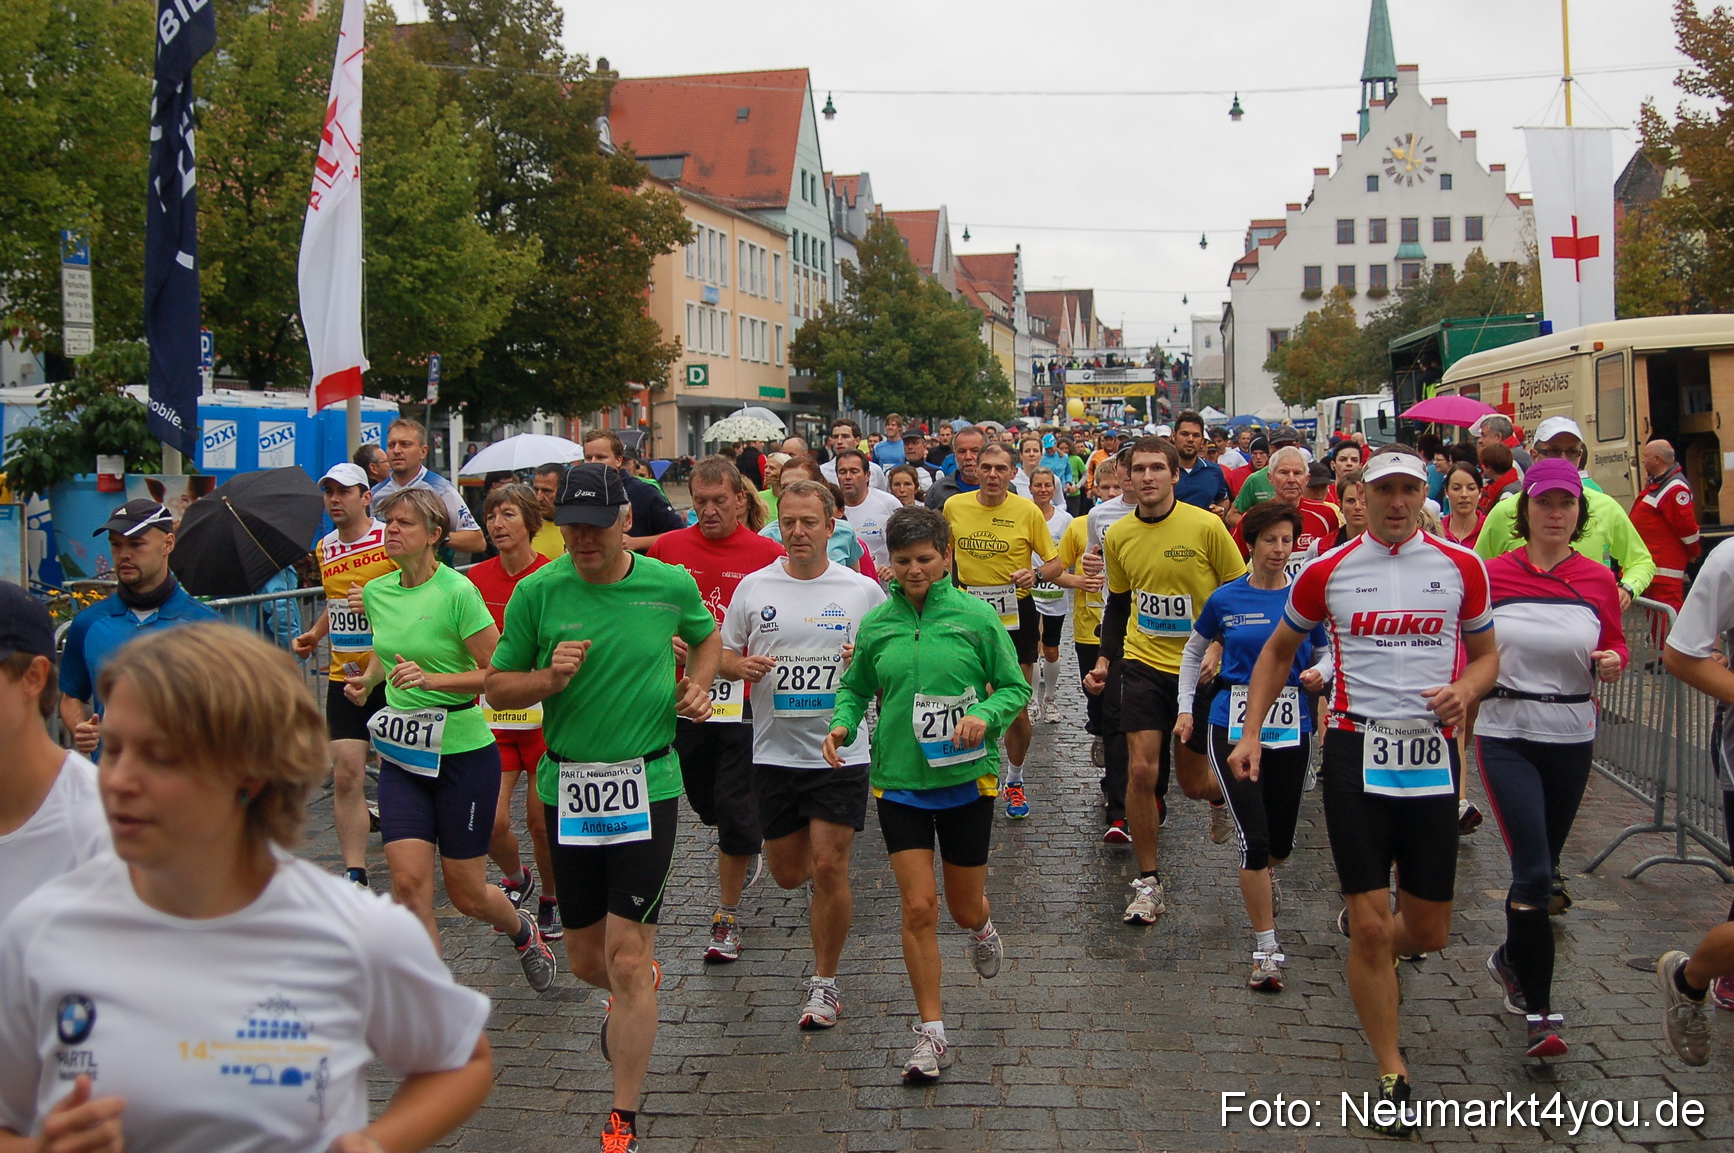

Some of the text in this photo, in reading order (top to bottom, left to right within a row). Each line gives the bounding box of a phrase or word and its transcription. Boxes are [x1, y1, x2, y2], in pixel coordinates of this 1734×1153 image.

[689, 366, 705, 384] D
[1094, 386, 1124, 395] START
[1519, 372, 1569, 400] Bayerisches
[1519, 402, 1543, 420] Rotes
[323, 551, 389, 579] MAX BÖGL
[1140, 592, 1186, 617] 2819
[330, 612, 369, 632] 2996
[760, 622, 779, 630] PARTL
[1146, 619, 1177, 630] Thomas
[1350, 611, 1445, 637] Hako
[1375, 638, 1443, 647] Clean ahead
[776, 665, 837, 691] 2827
[789, 697, 823, 707] Patrick
[915, 700, 942, 709] PARTL
[492, 711, 528, 722] gertraud
[374, 715, 434, 749] 3081
[1367, 724, 1394, 735] PARTL
[1372, 736, 1441, 766] 3108
[560, 768, 629, 779] PARTL Neumarkt
[567, 779, 639, 814] 3020
[581, 821, 628, 834] Andreas
